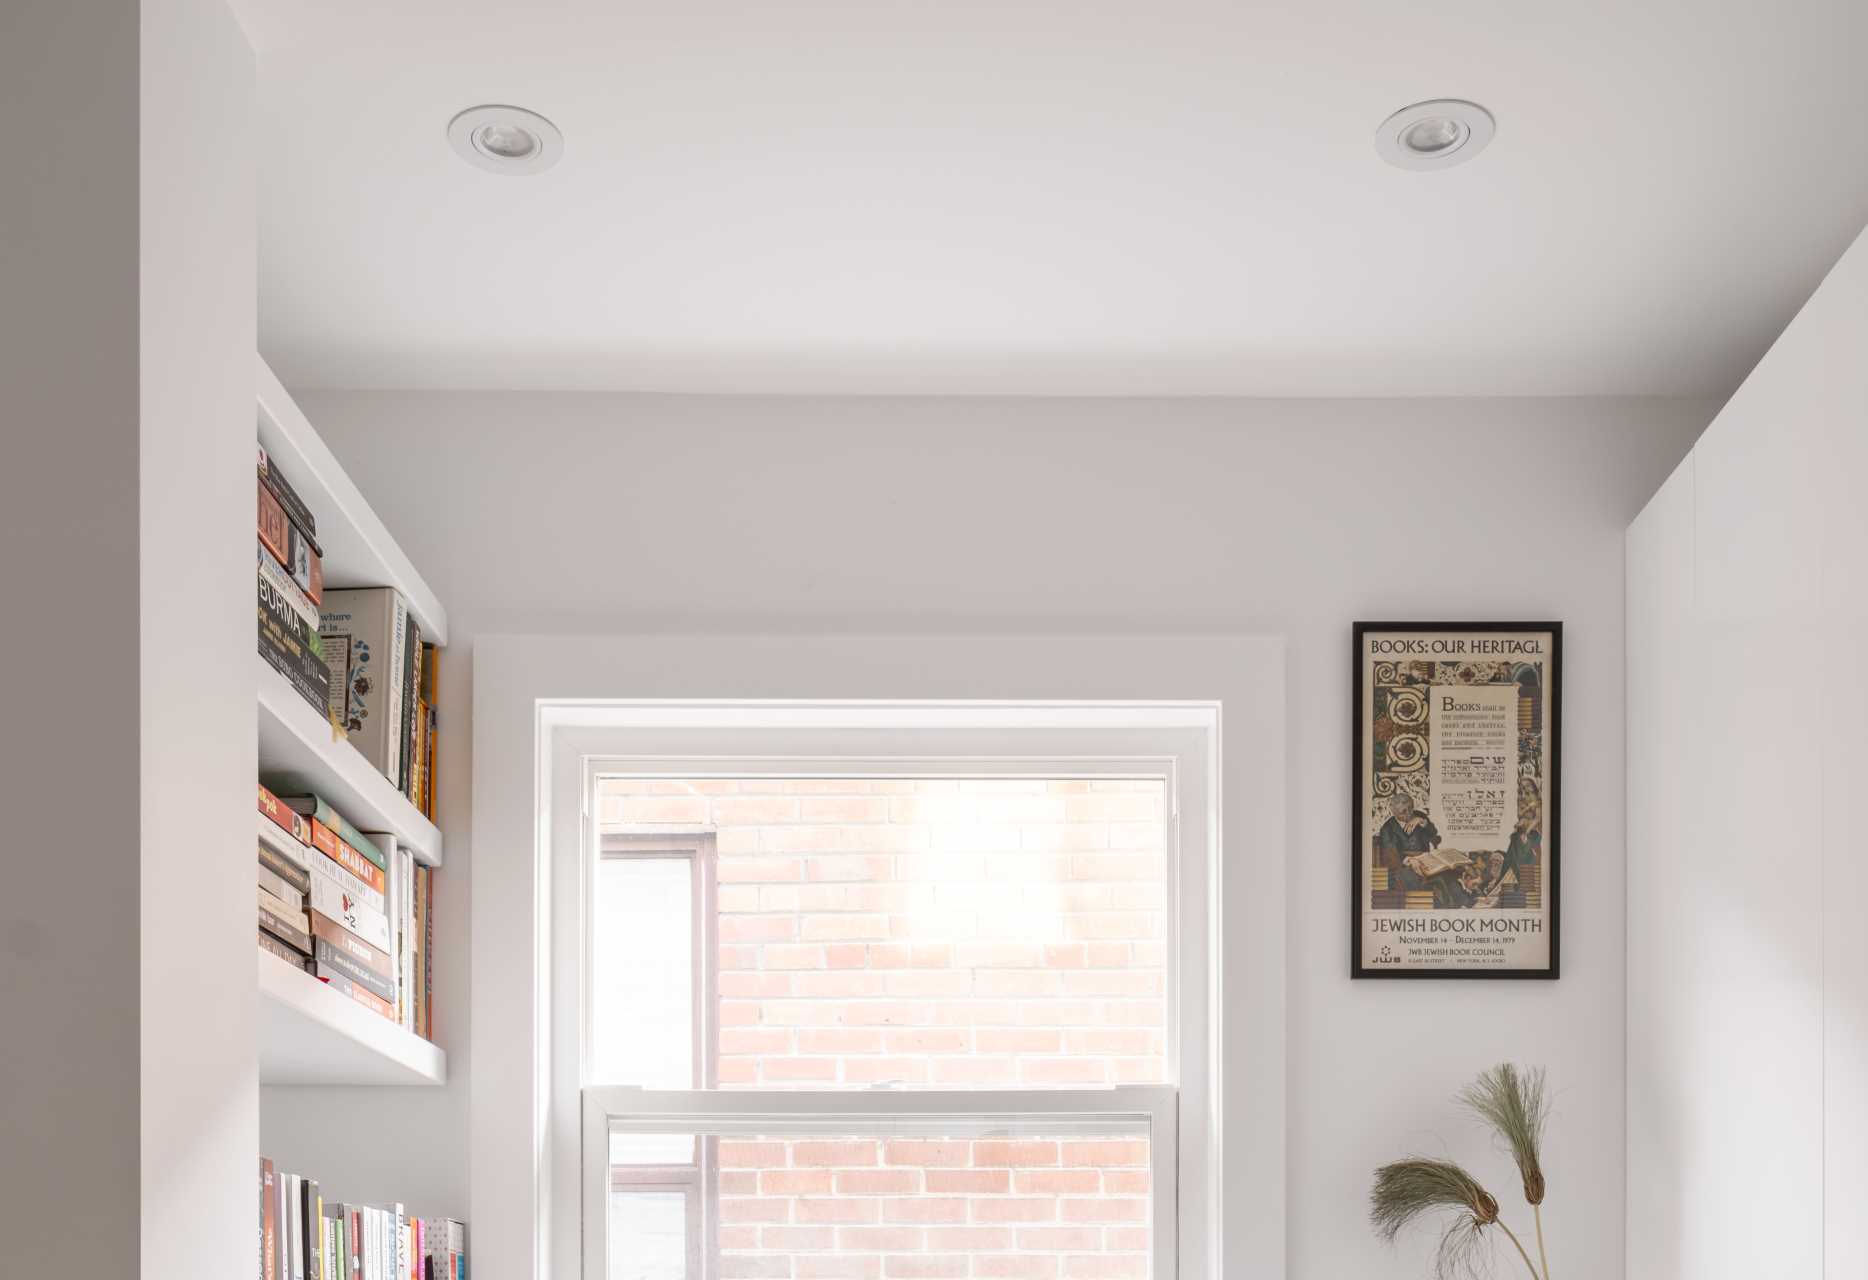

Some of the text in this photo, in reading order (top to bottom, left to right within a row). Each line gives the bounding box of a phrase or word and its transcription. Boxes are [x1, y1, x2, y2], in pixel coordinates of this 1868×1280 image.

[259, 577, 301, 637] BURMA
[1371, 640, 1429, 654] BOOKS:
[1431, 640, 1466, 654] OUR
[339, 843, 375, 882] SHABBAT
[1371, 919, 1542, 933] JEWISH BOOK MONTH
